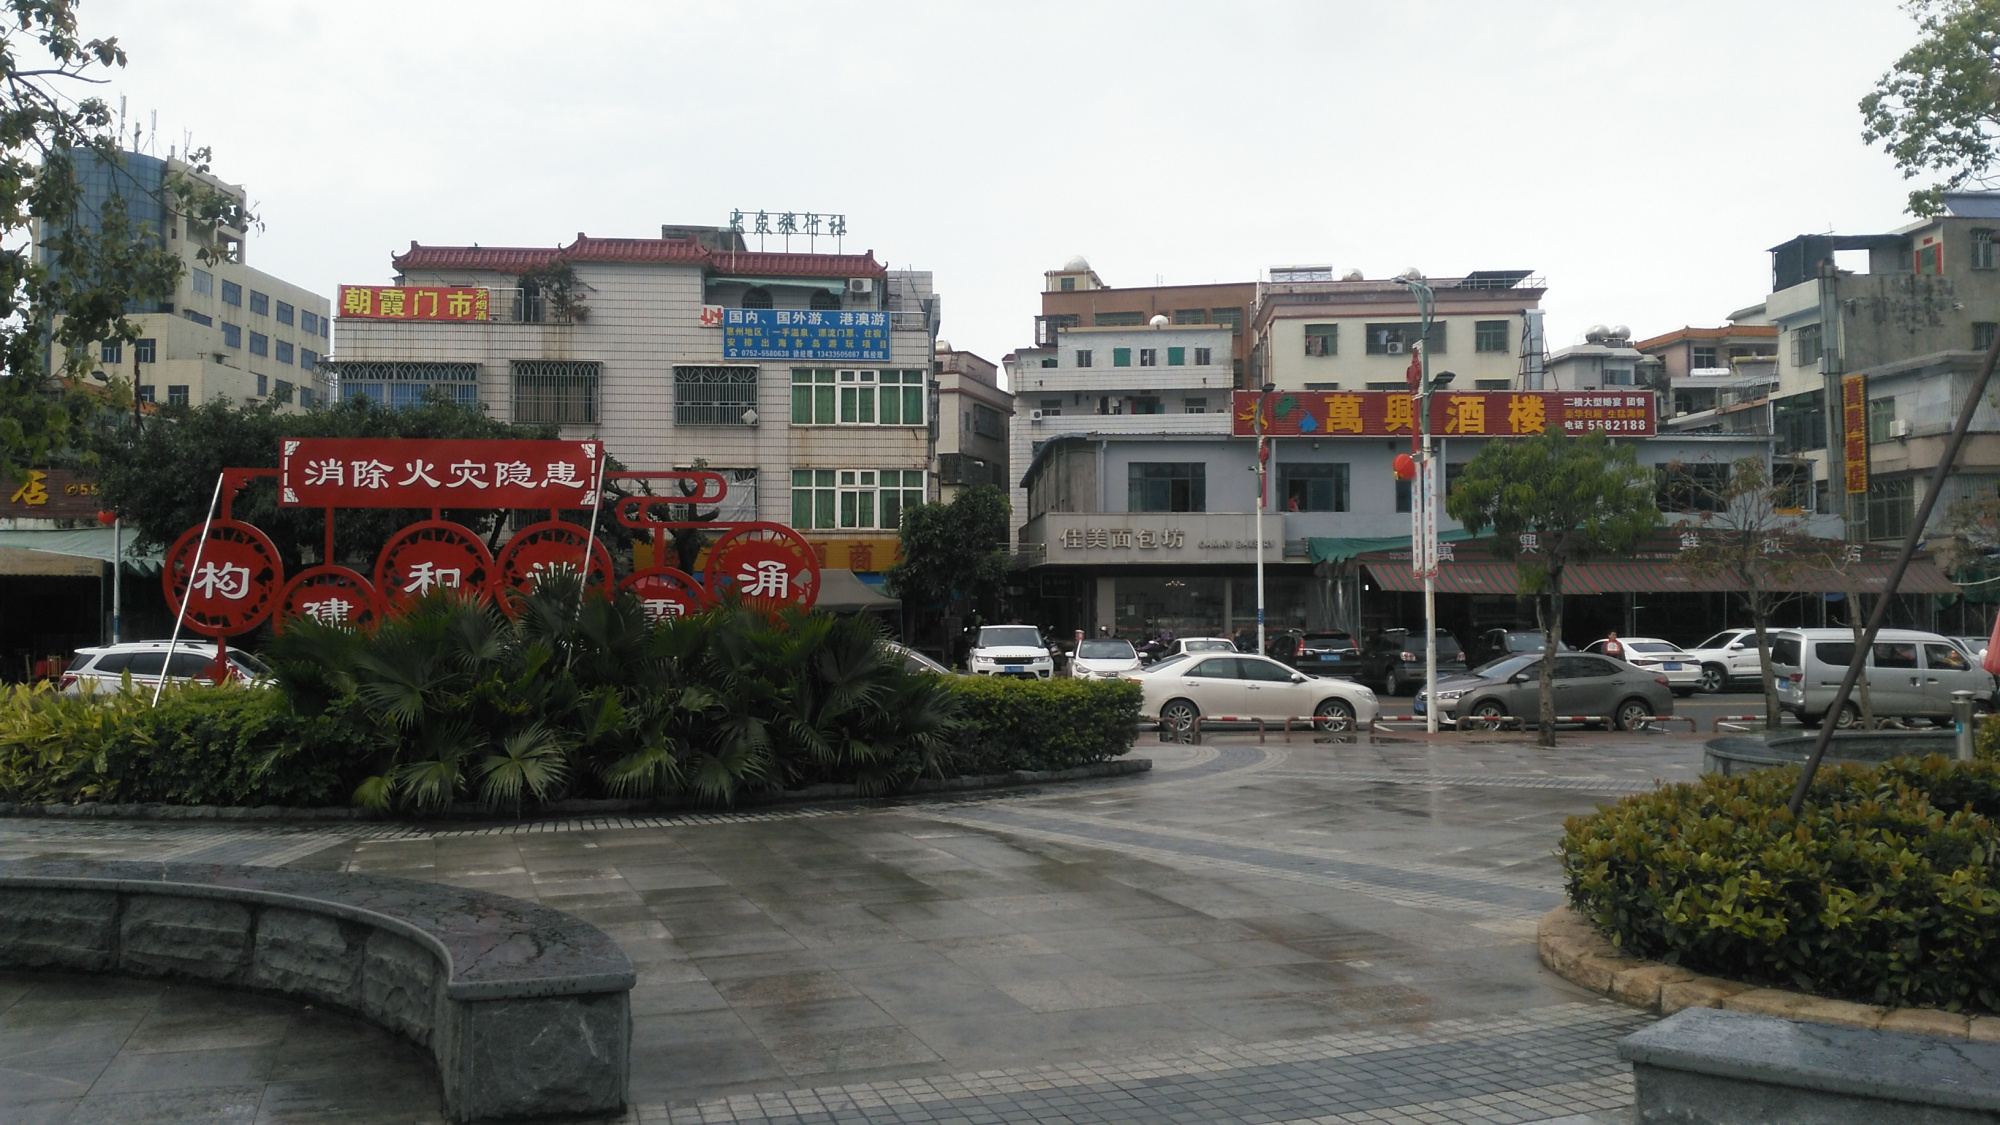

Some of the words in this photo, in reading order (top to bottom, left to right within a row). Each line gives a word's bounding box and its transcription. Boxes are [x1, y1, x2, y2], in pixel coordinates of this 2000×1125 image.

[729, 208, 847, 237] 大众旅行社
[343, 287, 474, 318] 朝霞门市
[475, 289, 487, 320] 茶烟酒
[728, 310, 886, 326] 国内、国外游、港澳游
[1324, 394, 1546, 434] 萬興酒楼
[1626, 397, 1645, 407] 团餐
[1565, 420, 1583, 430] 电话
[1588, 420, 1646, 430] 5582188
[304, 458, 585, 489] 消除火灾隐患
[1060, 528, 1185, 549] 佳美面包坊
[194, 561, 250, 600] 构
[403, 561, 461, 598] 和
[737, 560, 789, 598] 涌
